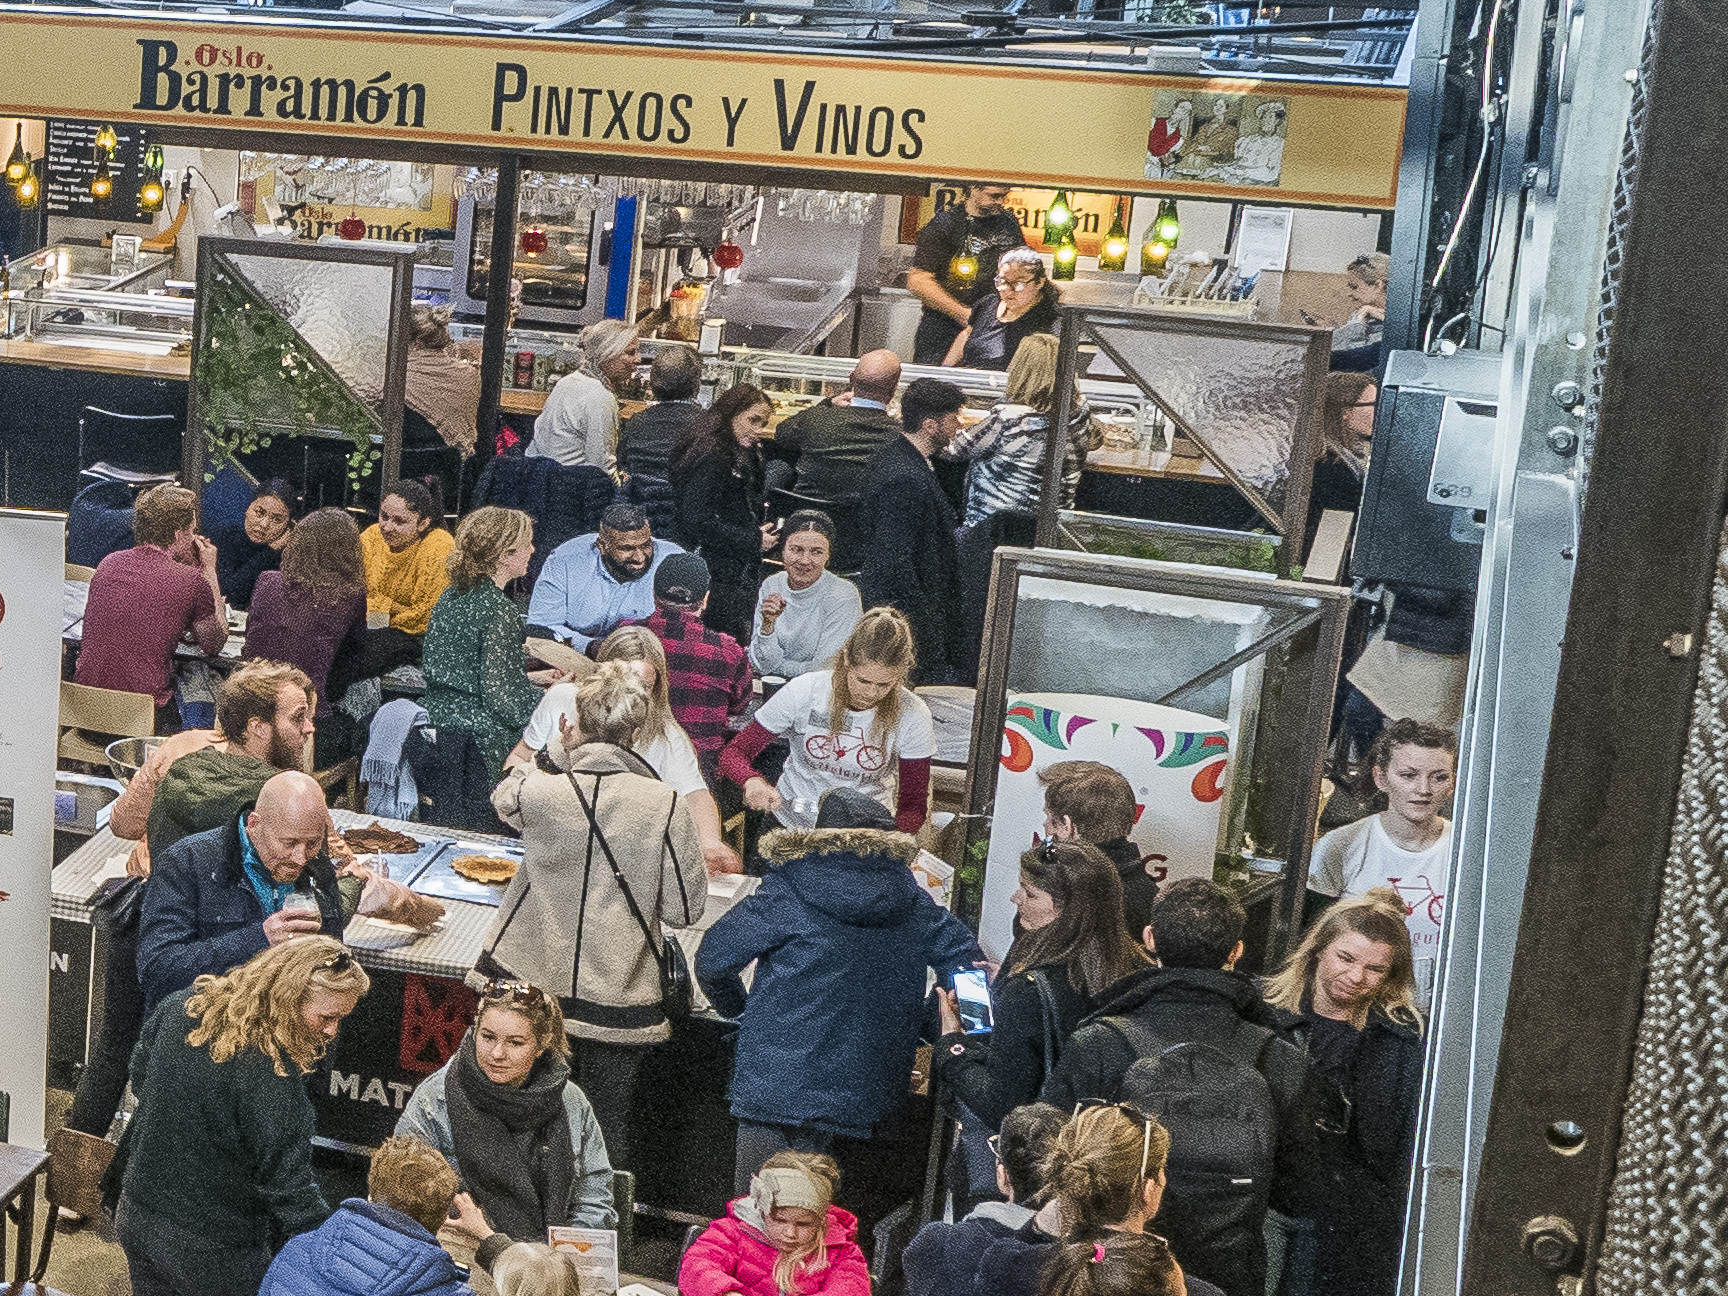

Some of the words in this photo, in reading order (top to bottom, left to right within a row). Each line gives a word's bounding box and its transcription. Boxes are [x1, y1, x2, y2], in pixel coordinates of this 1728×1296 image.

[193, 42, 267, 71] Oslo
[132, 38, 426, 128] Barramón
[489, 61, 694, 144] PINTXOS
[773, 78, 927, 161] VINOS
